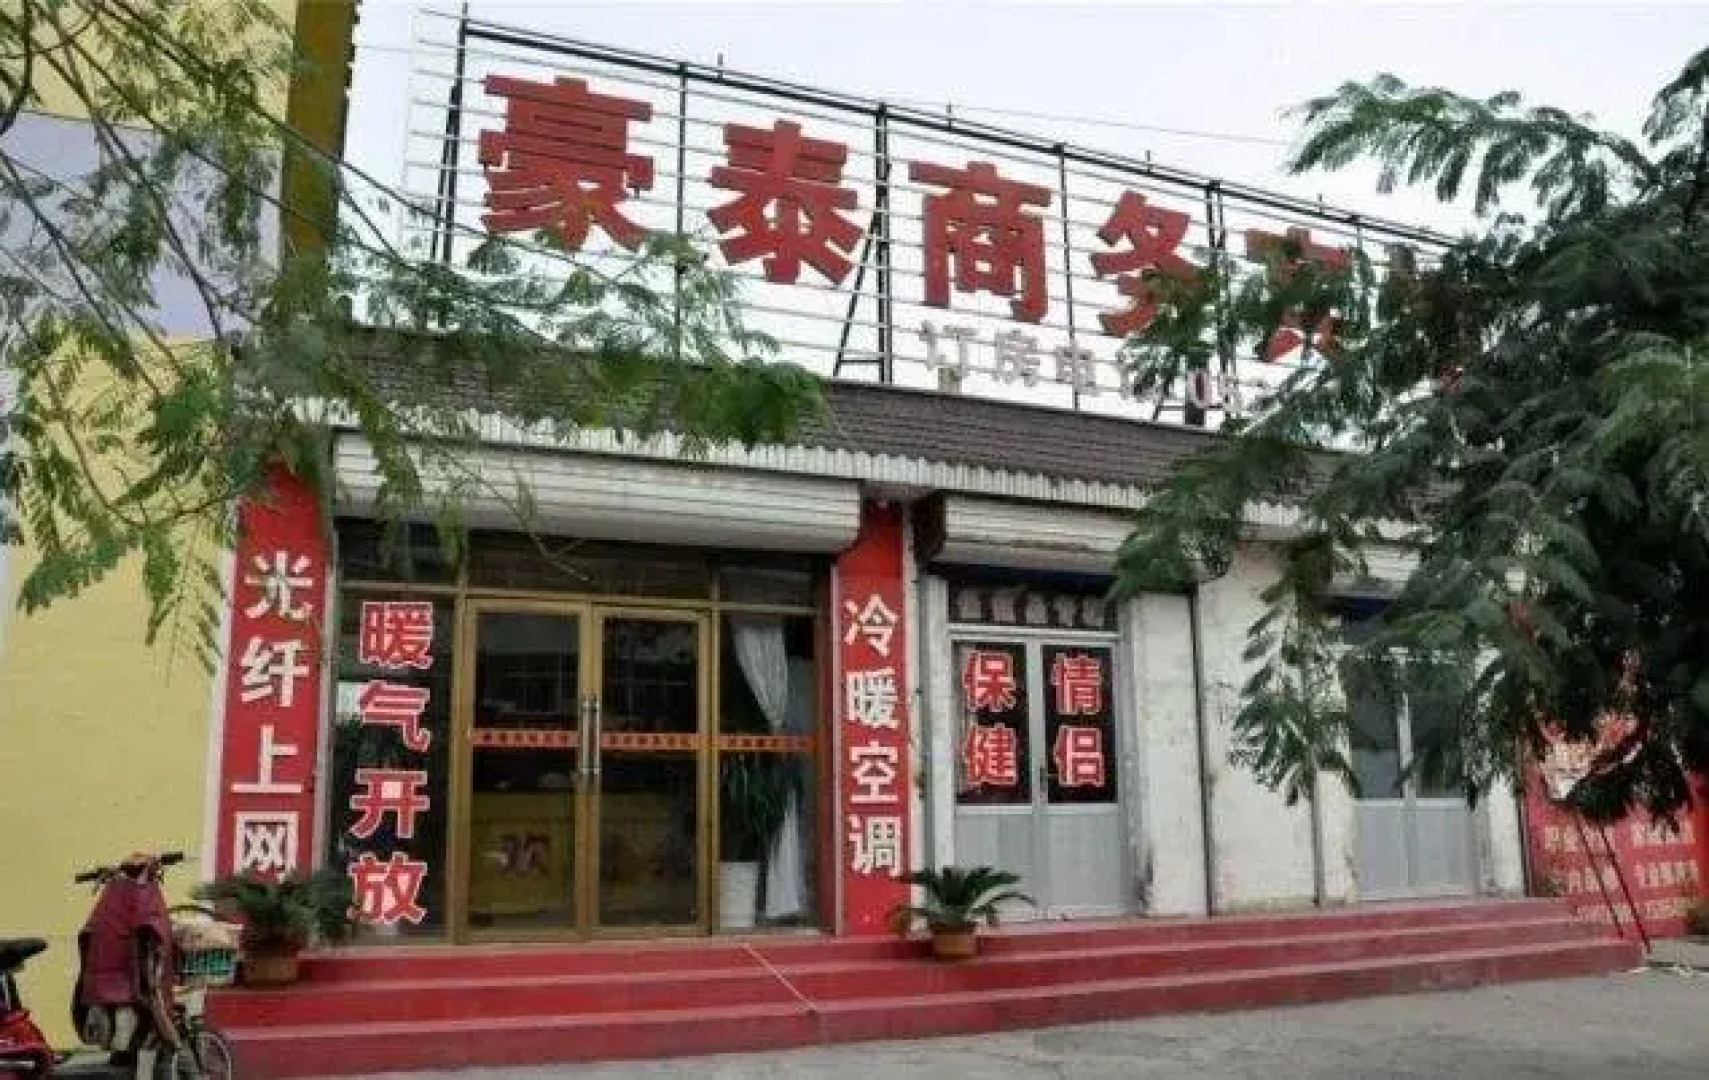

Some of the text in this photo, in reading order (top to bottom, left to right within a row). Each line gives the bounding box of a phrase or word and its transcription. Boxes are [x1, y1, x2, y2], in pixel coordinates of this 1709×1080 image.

[230, 550, 315, 884] 光纤上网
[346, 601, 435, 926] 暖气开放
[843, 594, 902, 876] 冷暖空调
[961, 649, 1018, 787] 保健
[1051, 652, 1106, 788] 情侣
